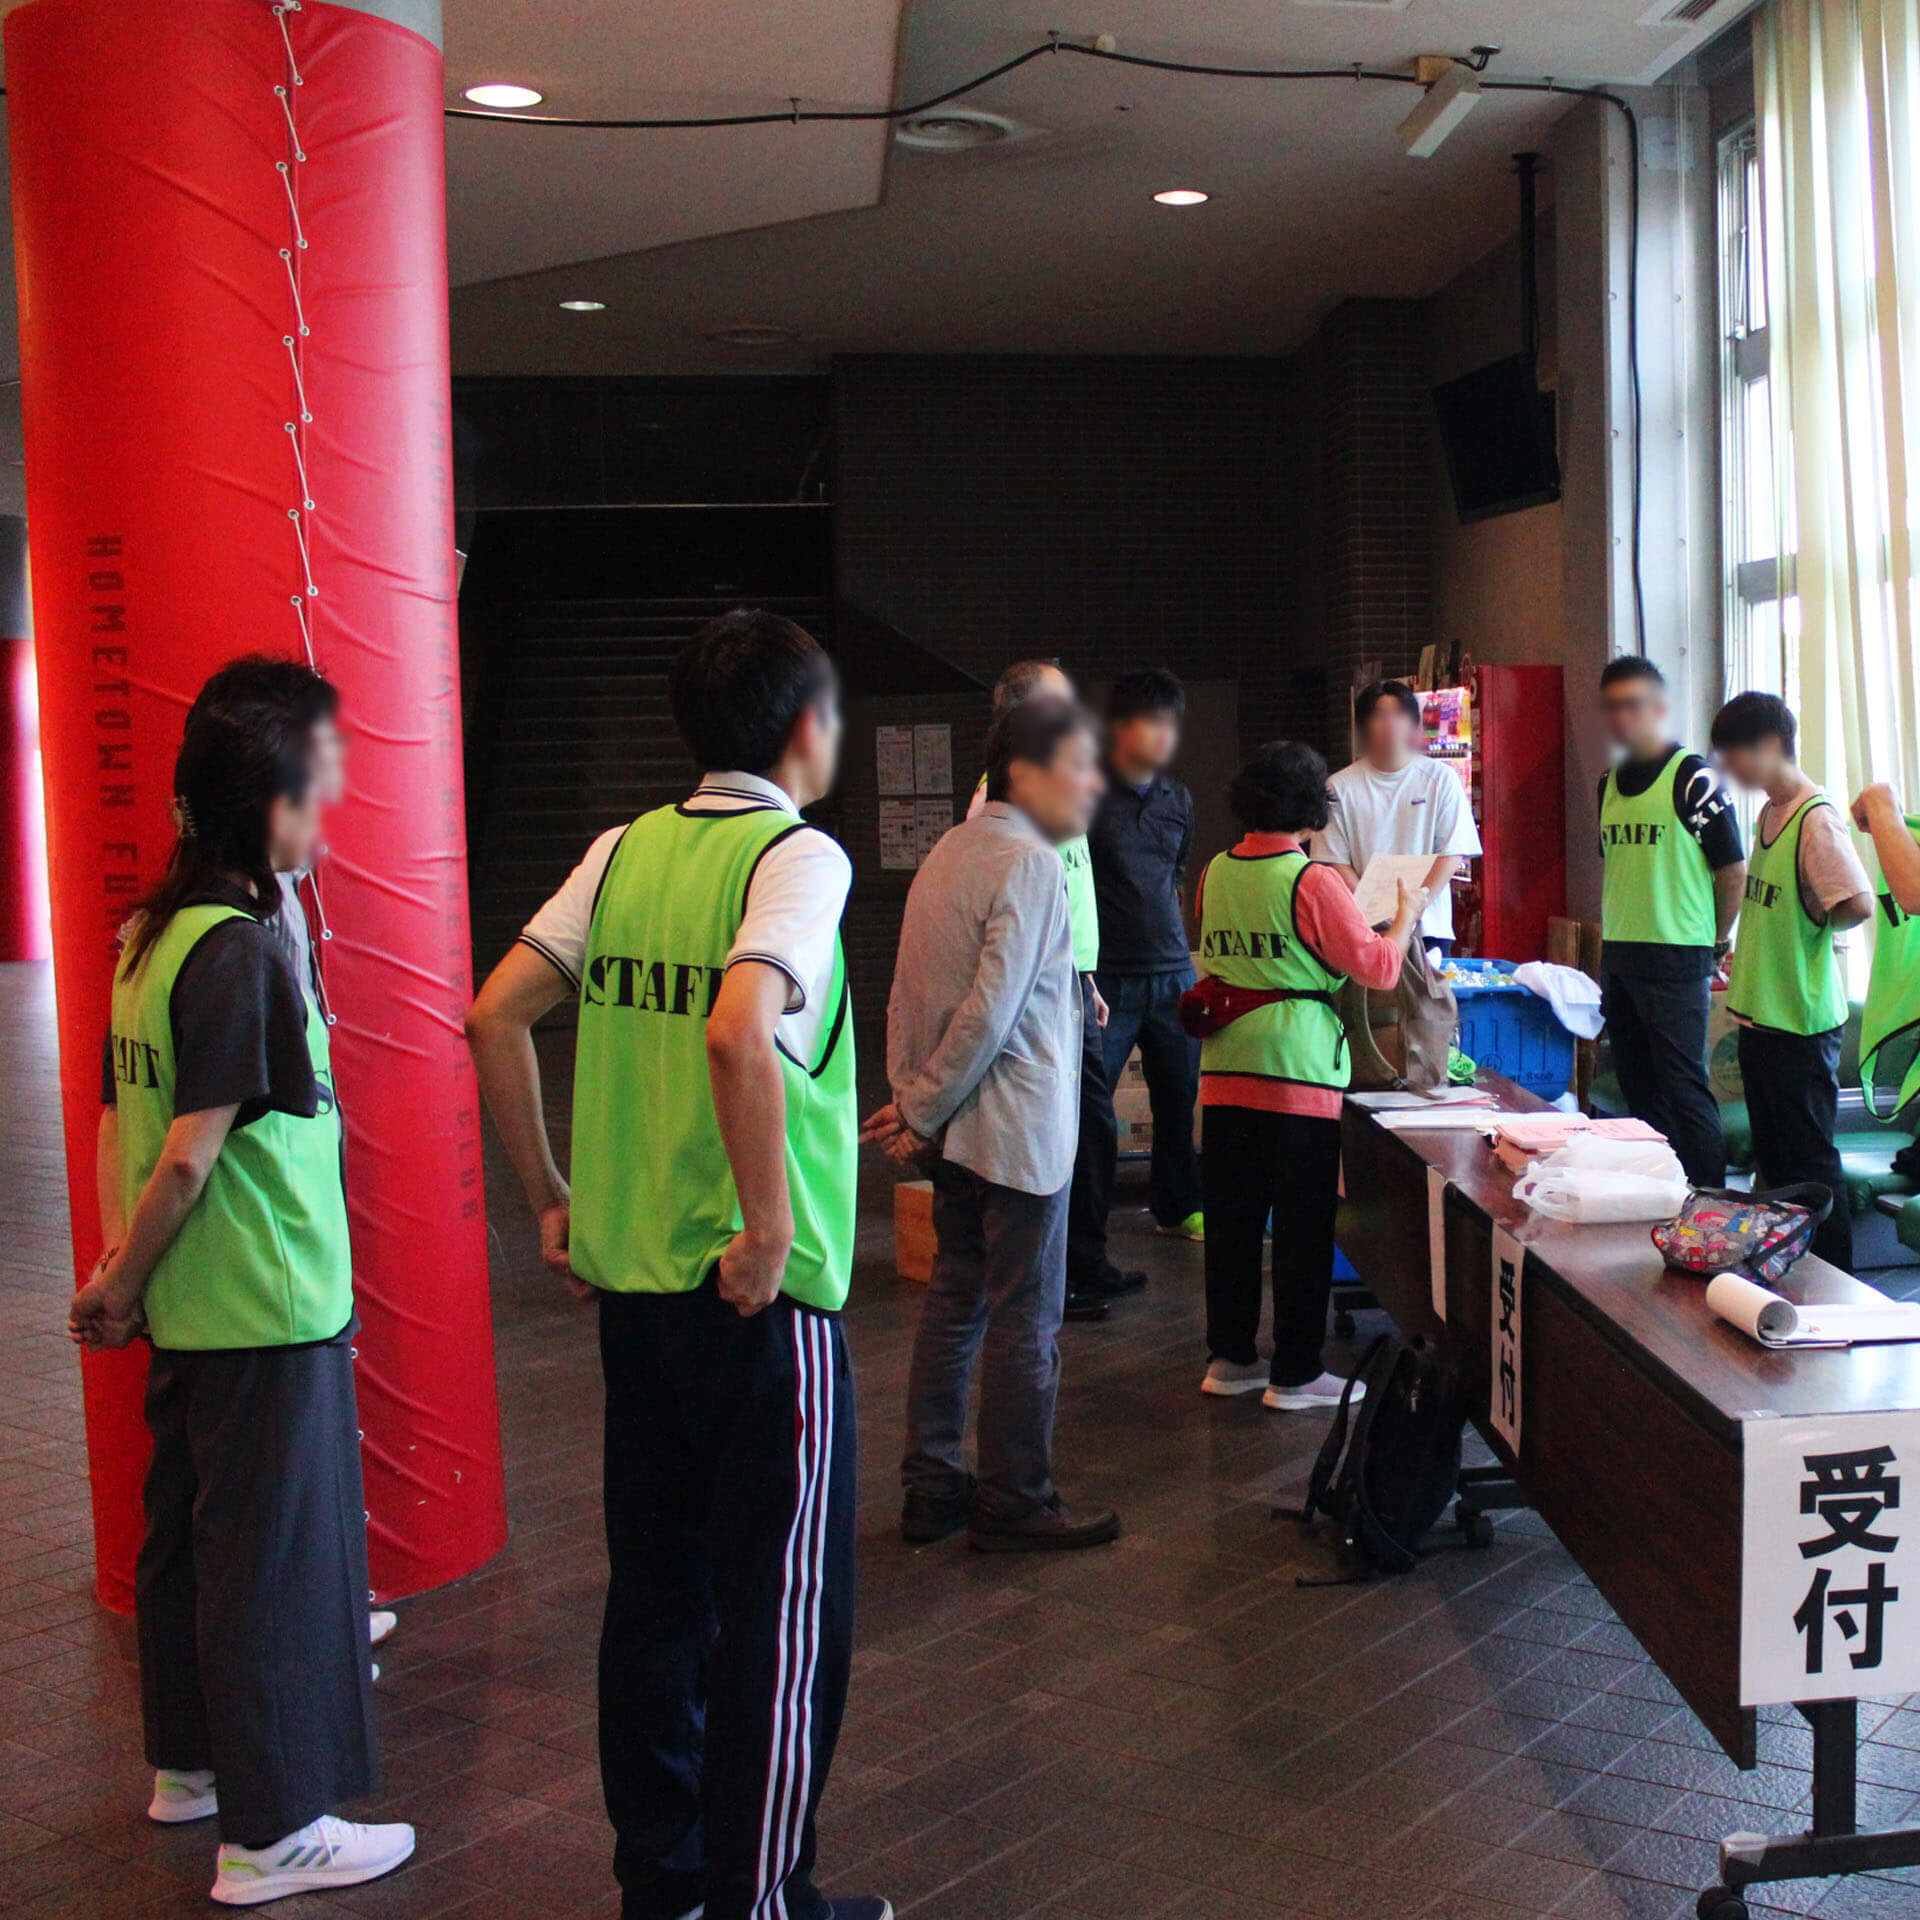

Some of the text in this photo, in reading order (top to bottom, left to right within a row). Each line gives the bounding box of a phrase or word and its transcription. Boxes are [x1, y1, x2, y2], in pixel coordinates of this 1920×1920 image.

[87, 534, 137, 807] HOMETOWN
[1205, 931, 1289, 960] STAFF
[1499, 1256, 1516, 1429] 受付
[1793, 1445, 1901, 1675] 受付
